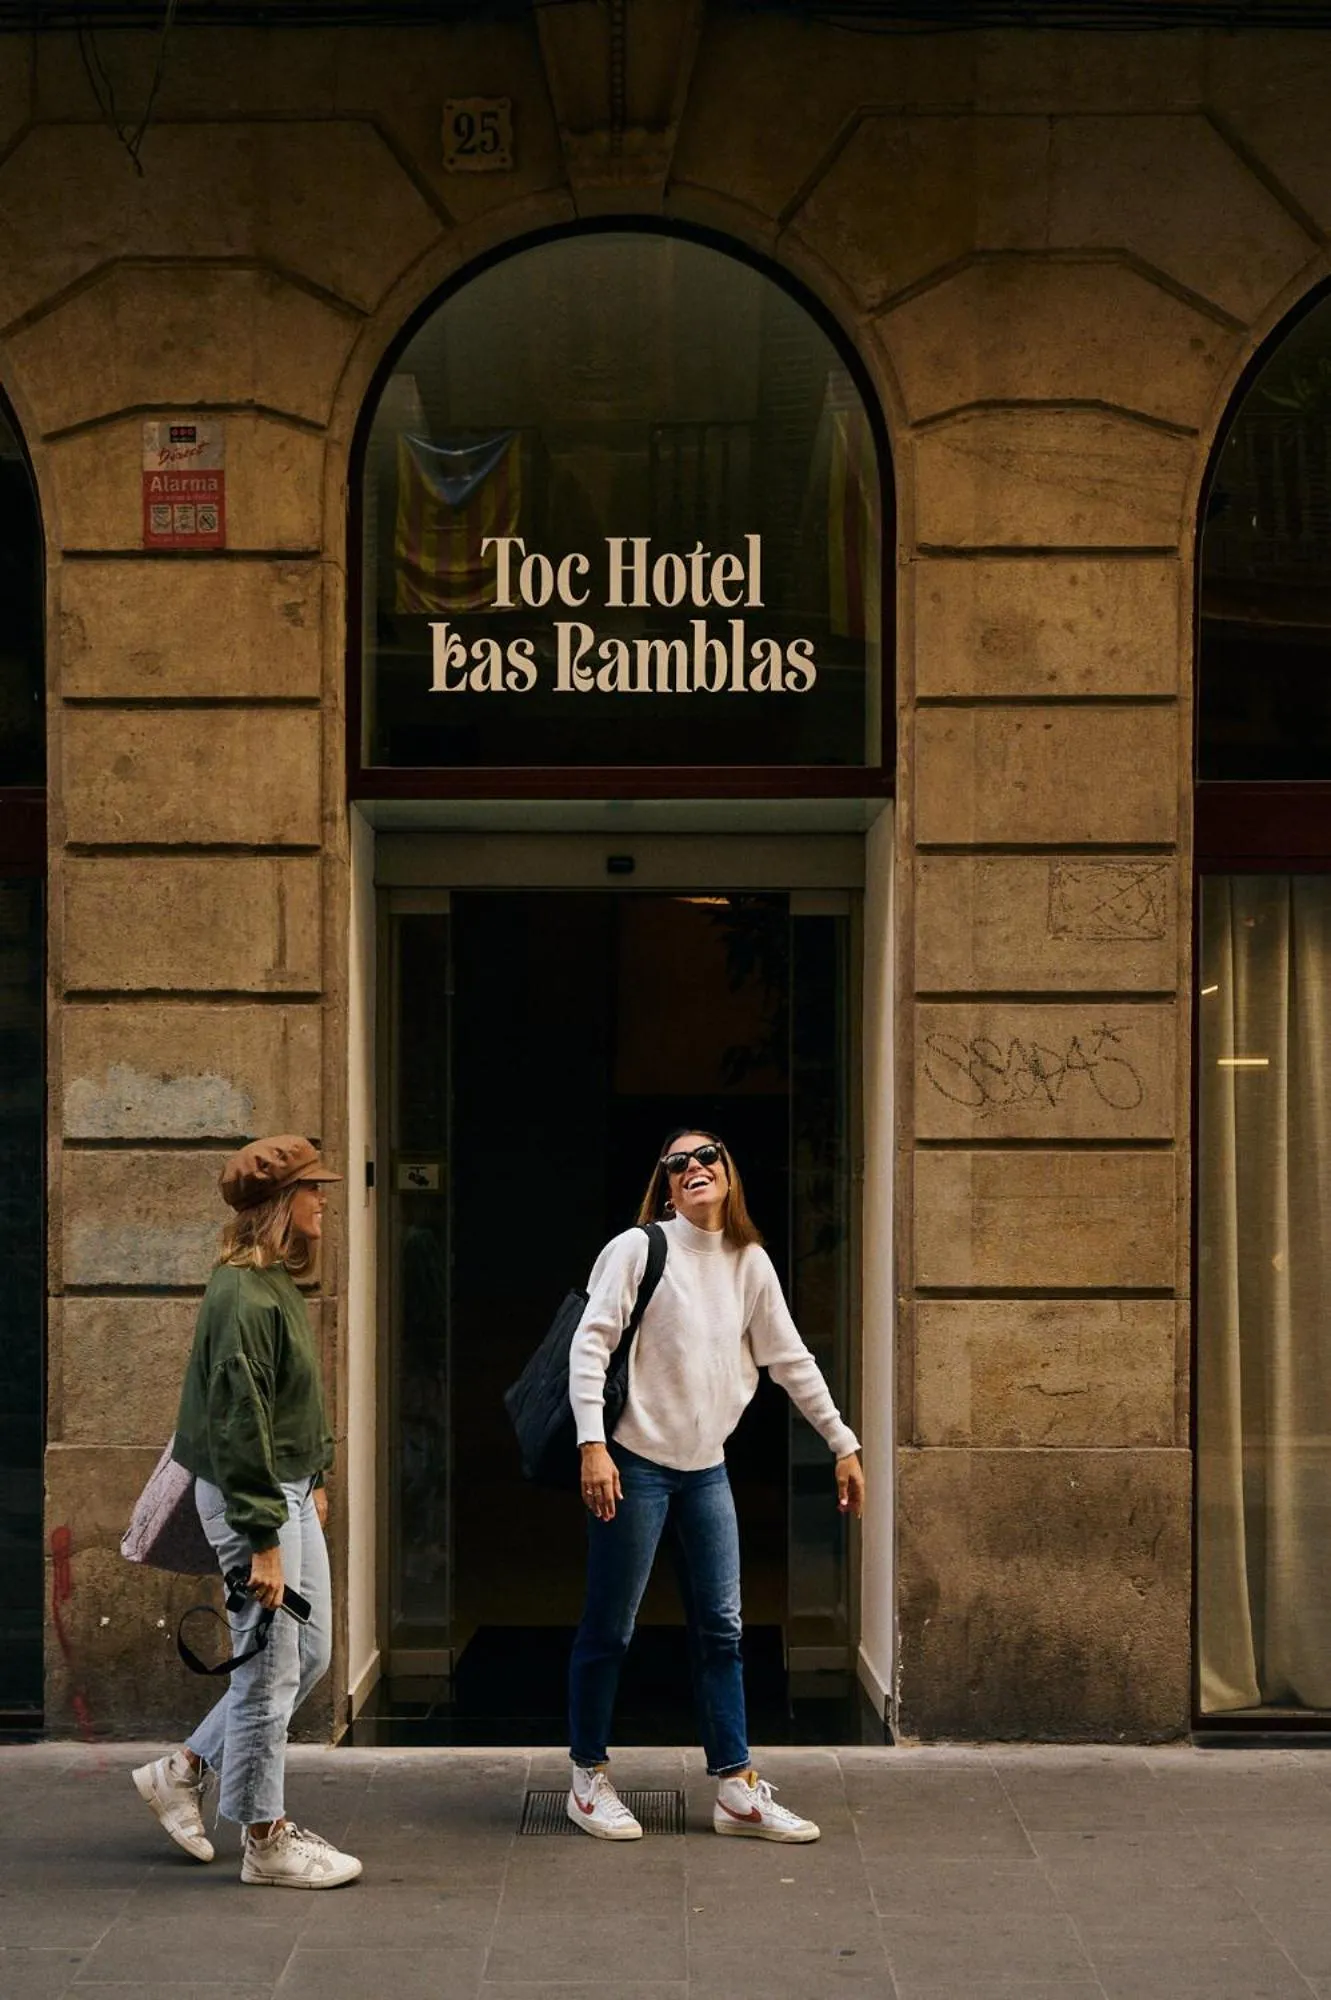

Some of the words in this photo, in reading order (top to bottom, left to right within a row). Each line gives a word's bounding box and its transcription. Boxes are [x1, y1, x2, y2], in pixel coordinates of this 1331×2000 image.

[150, 476, 218, 493] Alarma
[480, 537, 590, 607] Toc
[604, 534, 765, 608] Hotel
[427, 622, 538, 692] Las
[552, 619, 817, 693] Ramblas
